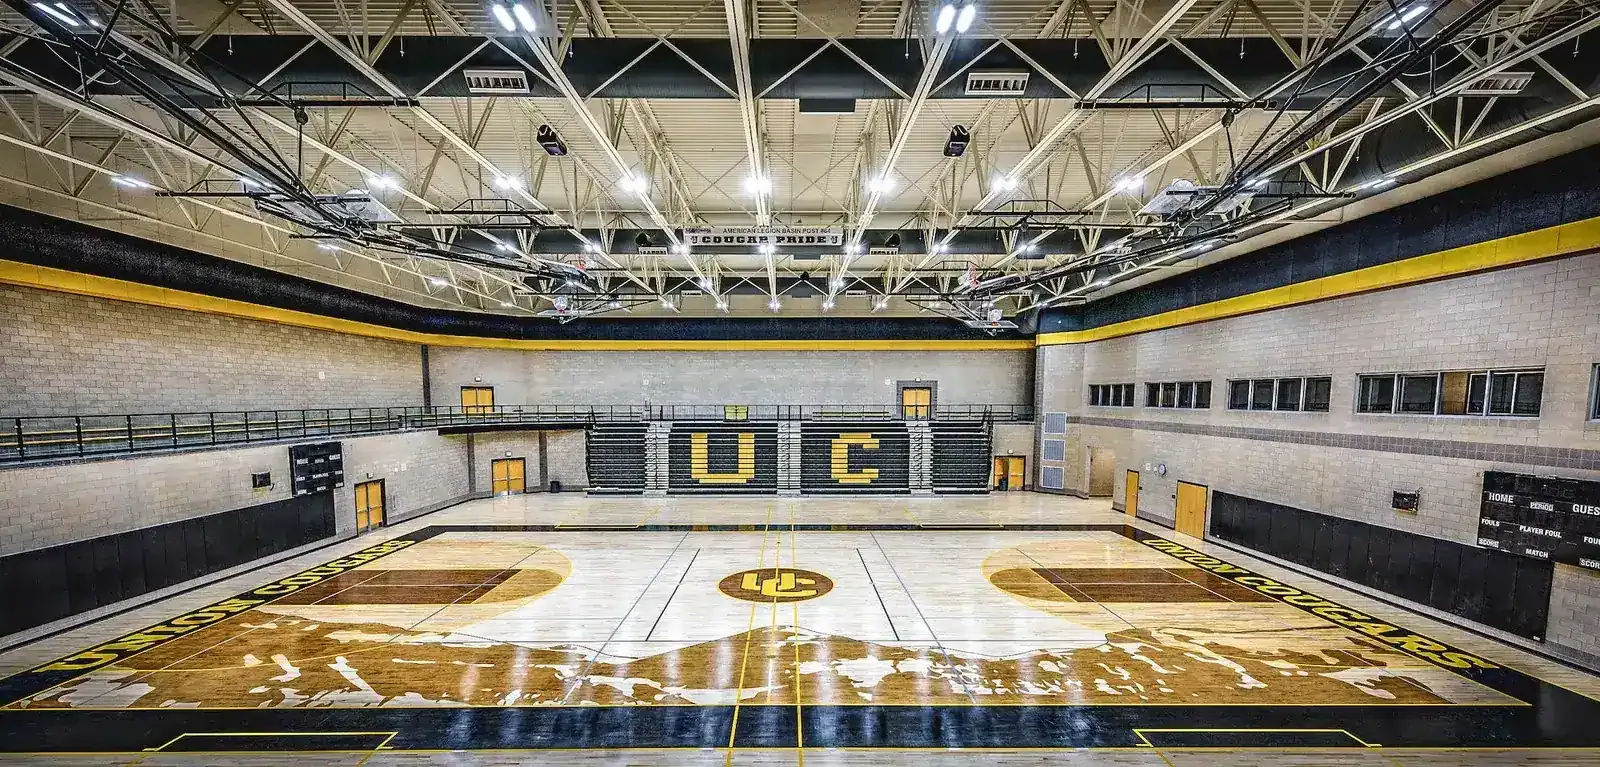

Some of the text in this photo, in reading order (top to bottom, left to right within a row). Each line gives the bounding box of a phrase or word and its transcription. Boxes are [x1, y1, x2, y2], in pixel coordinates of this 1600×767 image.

[701, 235, 769, 244] COUGAR
[776, 235, 827, 244] PRIDE
[691, 433, 880, 484] U C
[1489, 493, 1514, 503] HOME
[1530, 502, 1553, 512] PERIOD
[1481, 518, 1600, 546] FOULS PLAYER FOUL FOU
[1479, 537, 1499, 548] SCORE
[1525, 548, 1548, 559] MATCH
[31, 540, 416, 674] UNION COUGARS
[1141, 539, 1499, 669] UNION COUGARS
